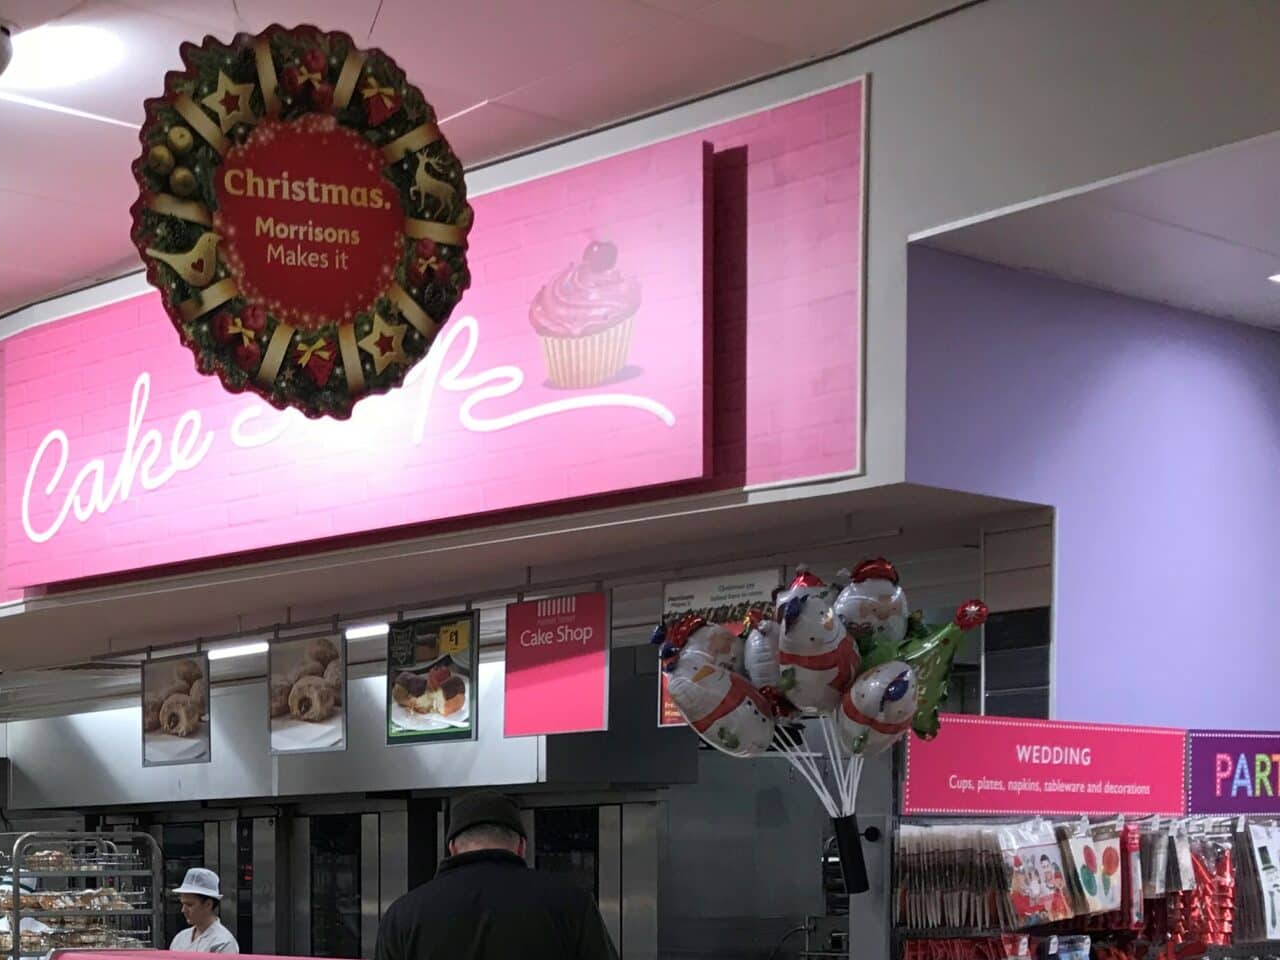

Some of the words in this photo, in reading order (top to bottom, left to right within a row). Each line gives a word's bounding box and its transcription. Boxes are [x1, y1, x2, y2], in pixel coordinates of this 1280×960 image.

[224, 168, 391, 210] Christmas.
[255, 216, 360, 245] Morrisons
[267, 244, 328, 269] Makes
[335, 249, 348, 270] it
[21, 372, 215, 543] Cake
[520, 628, 553, 647] Cake
[556, 625, 593, 645] Shop
[1016, 744, 1092, 766] WEDDING
[949, 774, 975, 792] Cups,
[977, 776, 1006, 792] plates,
[1008, 778, 1042, 795] napkins,
[1044, 779, 1085, 793] tableware
[1087, 780, 1102, 794] and
[1104, 780, 1151, 795] decorations
